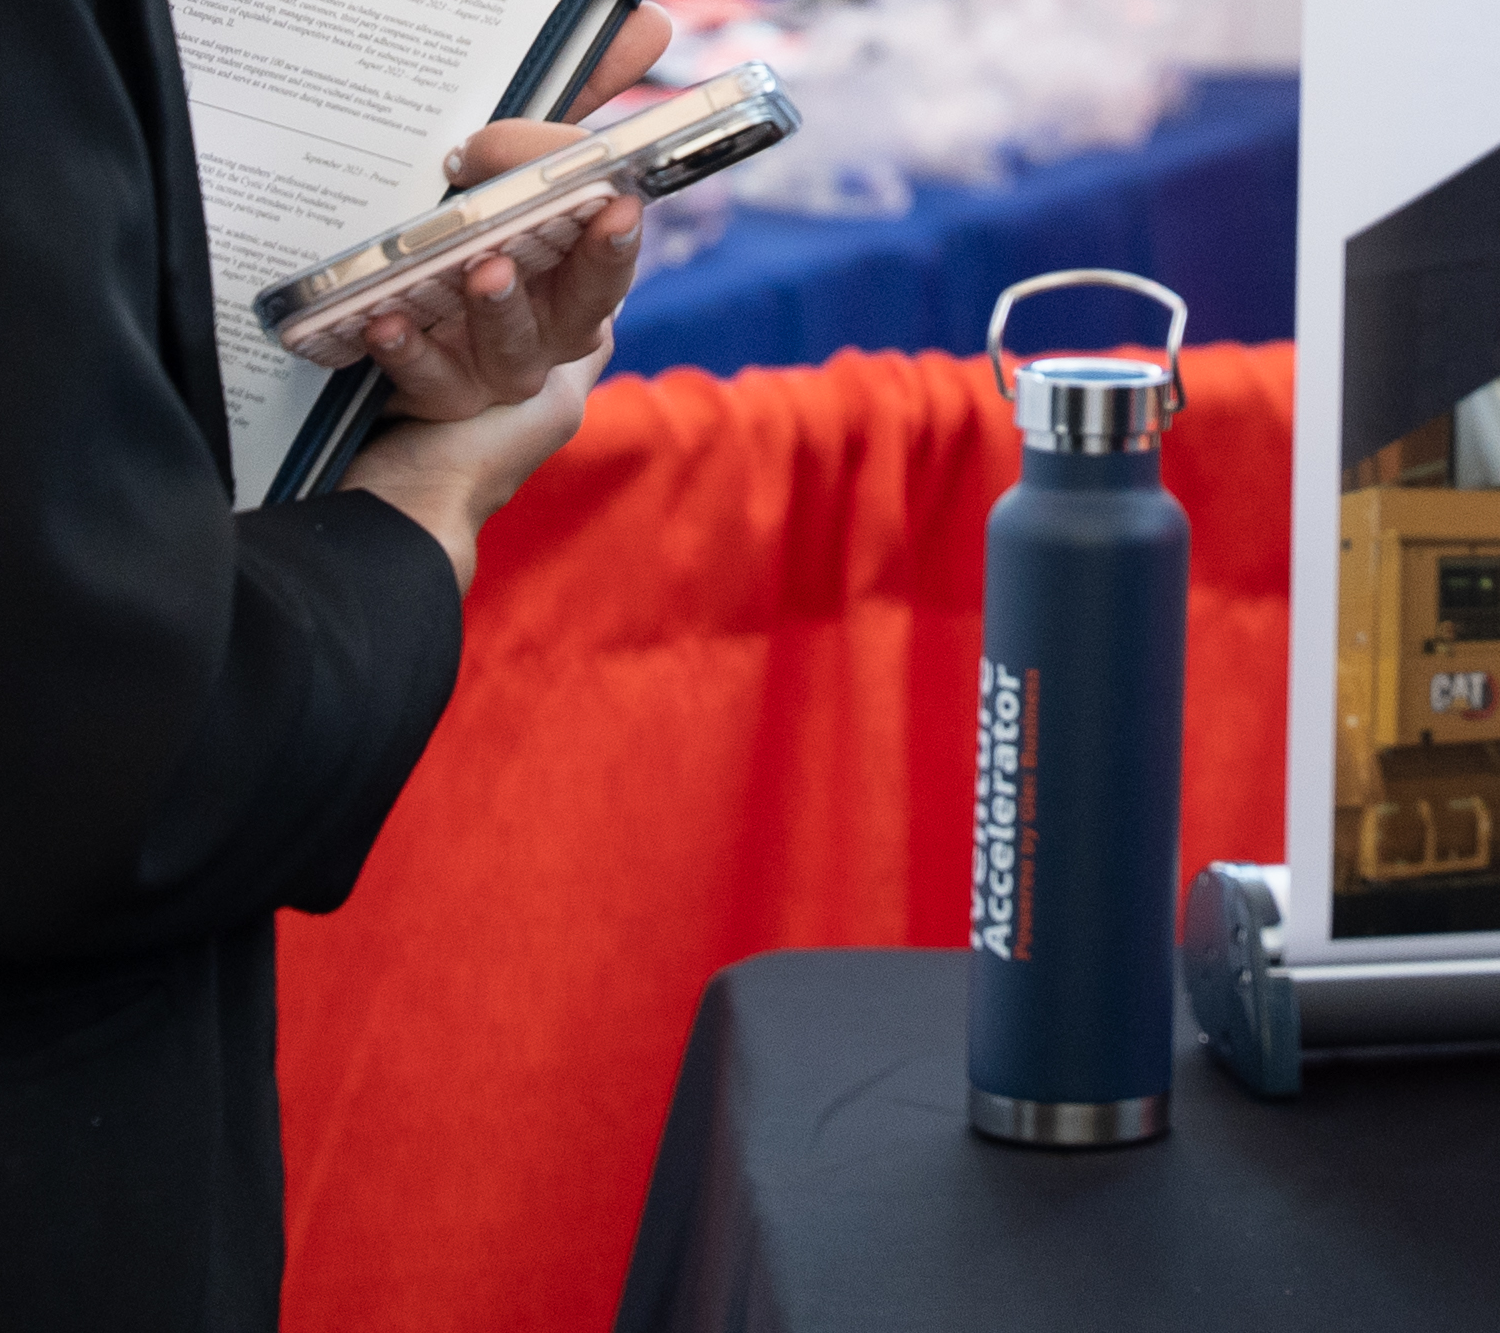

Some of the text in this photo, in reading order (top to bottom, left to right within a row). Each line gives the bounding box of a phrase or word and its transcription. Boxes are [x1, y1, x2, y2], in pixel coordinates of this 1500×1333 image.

[1019, 668, 1040, 769] Business
[1430, 670, 1488, 715] CAT
[982, 664, 1022, 961] Accelerator
[1019, 825, 1040, 855] by
